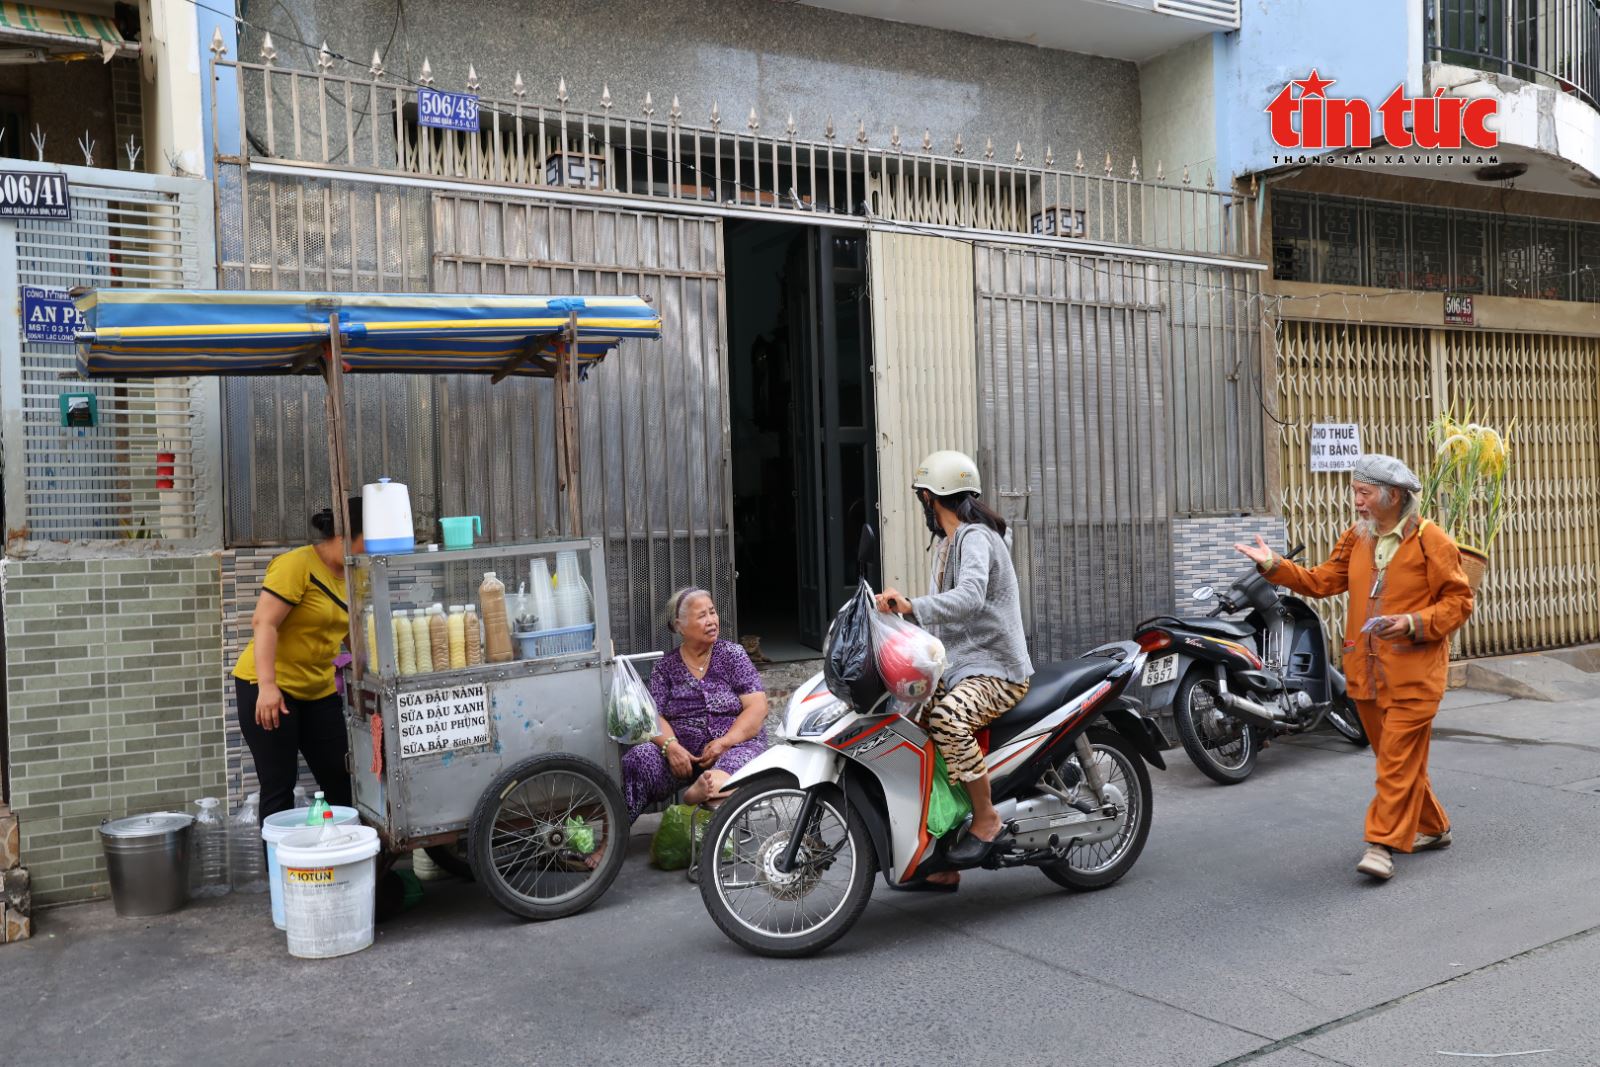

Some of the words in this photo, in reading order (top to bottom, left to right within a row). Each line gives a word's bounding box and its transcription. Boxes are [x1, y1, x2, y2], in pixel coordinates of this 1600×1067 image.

[422, 92, 476, 120] 506/43
[30, 305, 57, 323] AN
[1328, 425, 1355, 440] THUÊ
[400, 694, 423, 707] SỮA
[452, 686, 484, 699] NÀNH
[400, 709, 424, 723] SỮA
[427, 705, 450, 720] ĐẬU
[453, 701, 484, 715] XANH
[402, 725, 423, 737] SỮA
[425, 721, 448, 734] ĐẬU
[403, 741, 426, 755] SỮA
